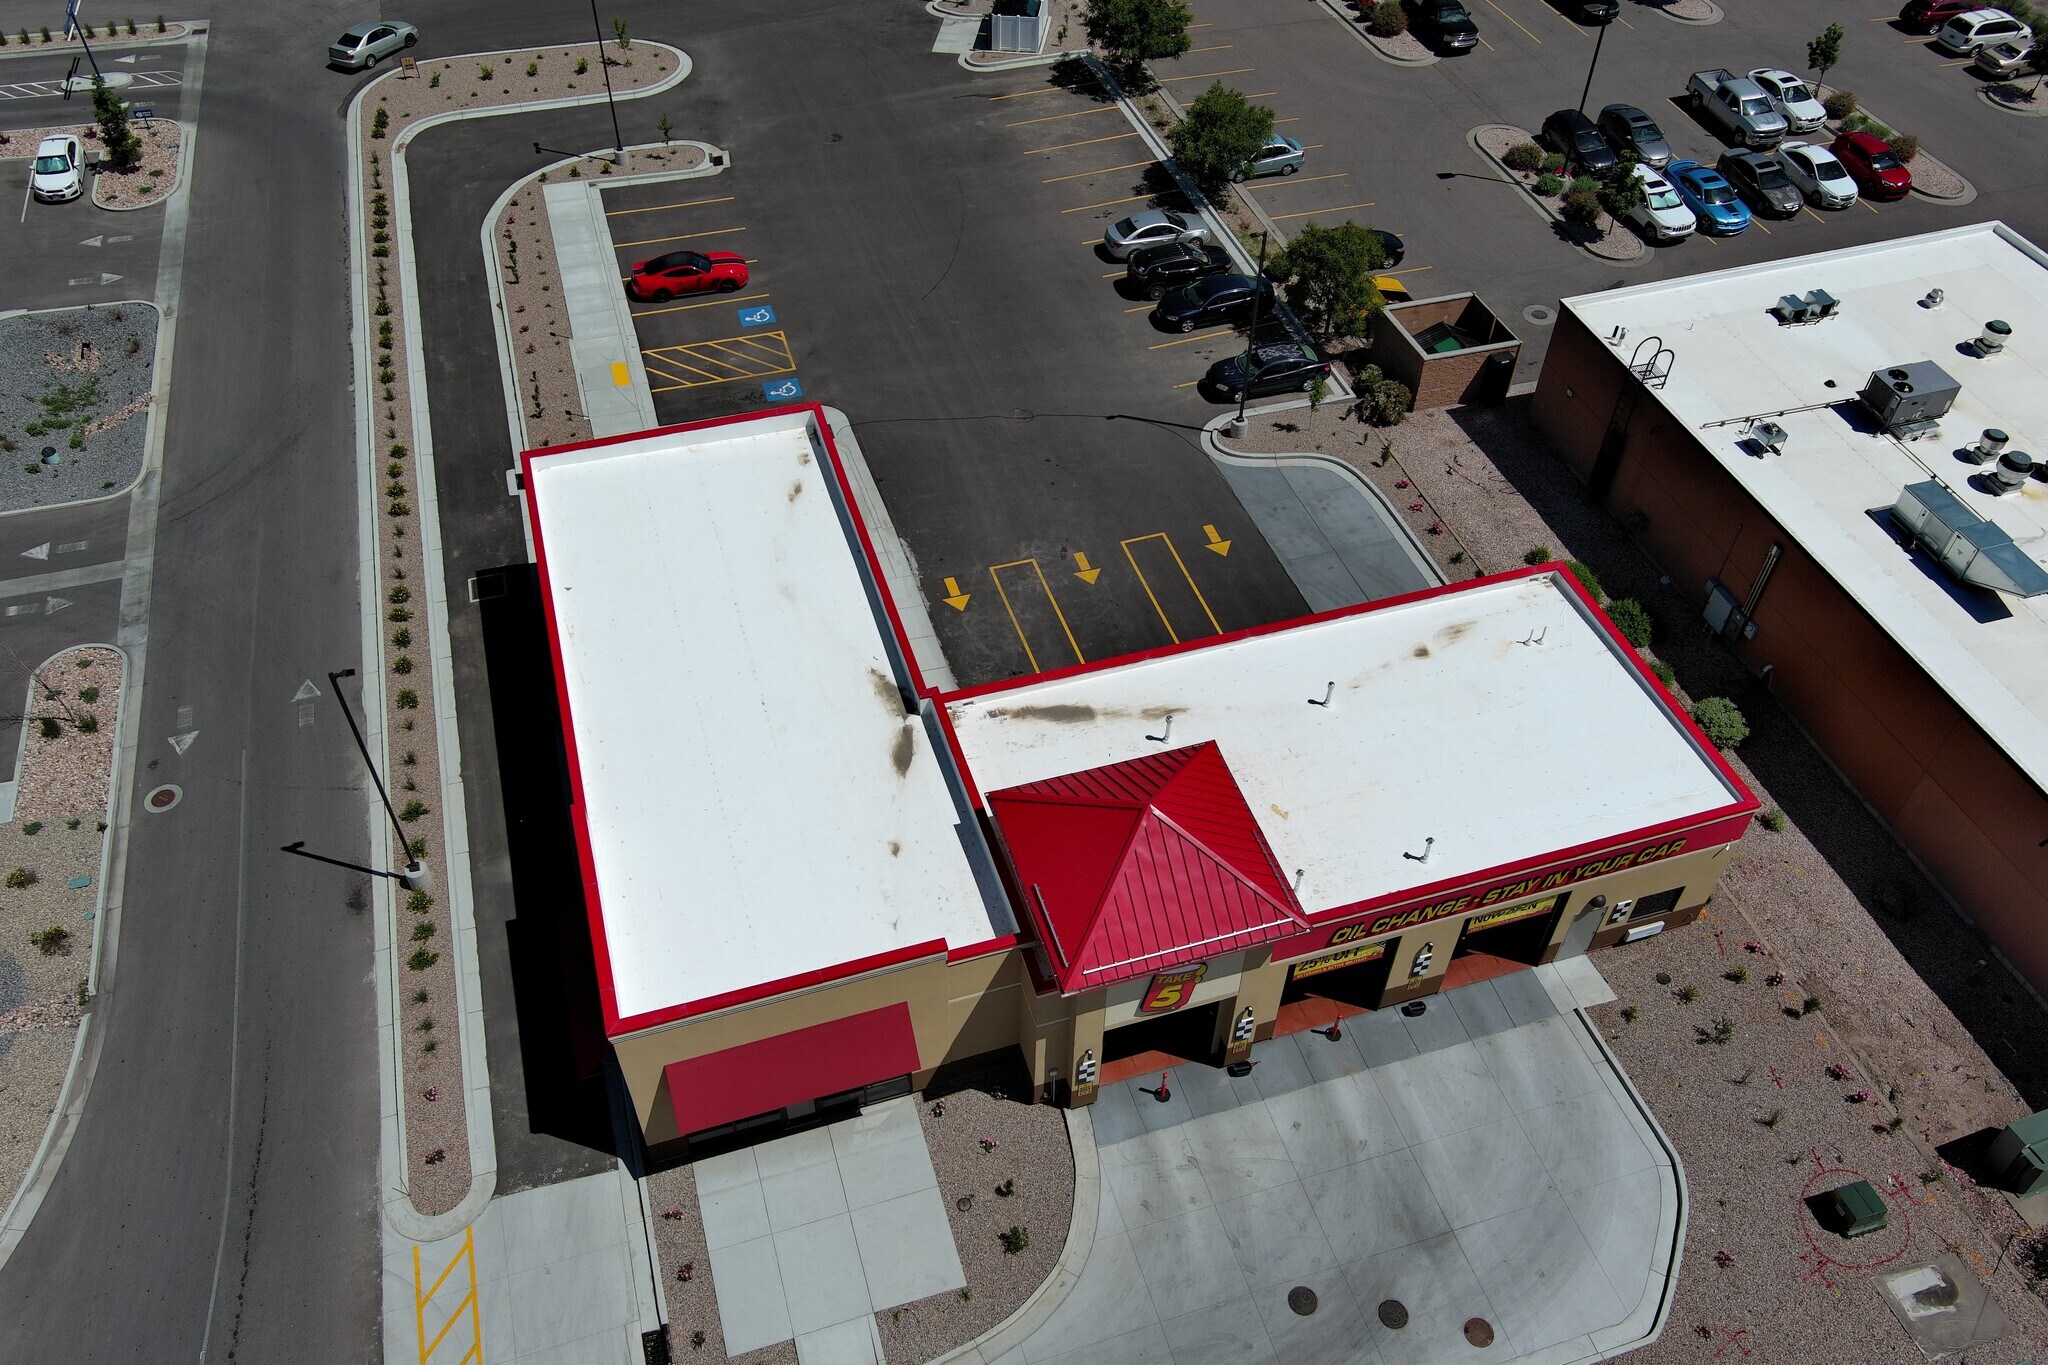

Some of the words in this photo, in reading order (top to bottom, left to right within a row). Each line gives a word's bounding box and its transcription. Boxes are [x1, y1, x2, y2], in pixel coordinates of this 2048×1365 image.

[1331, 923, 1367, 943] OIL
[1371, 896, 1471, 933] CHANGE
[1483, 877, 1542, 903] STAY
[1541, 870, 1570, 888] IN
[1574, 853, 1636, 880] YOUR
[1637, 839, 1687, 863] CAR
[1157, 973, 1192, 984] TAKE
[1149, 984, 1181, 1007] 5
